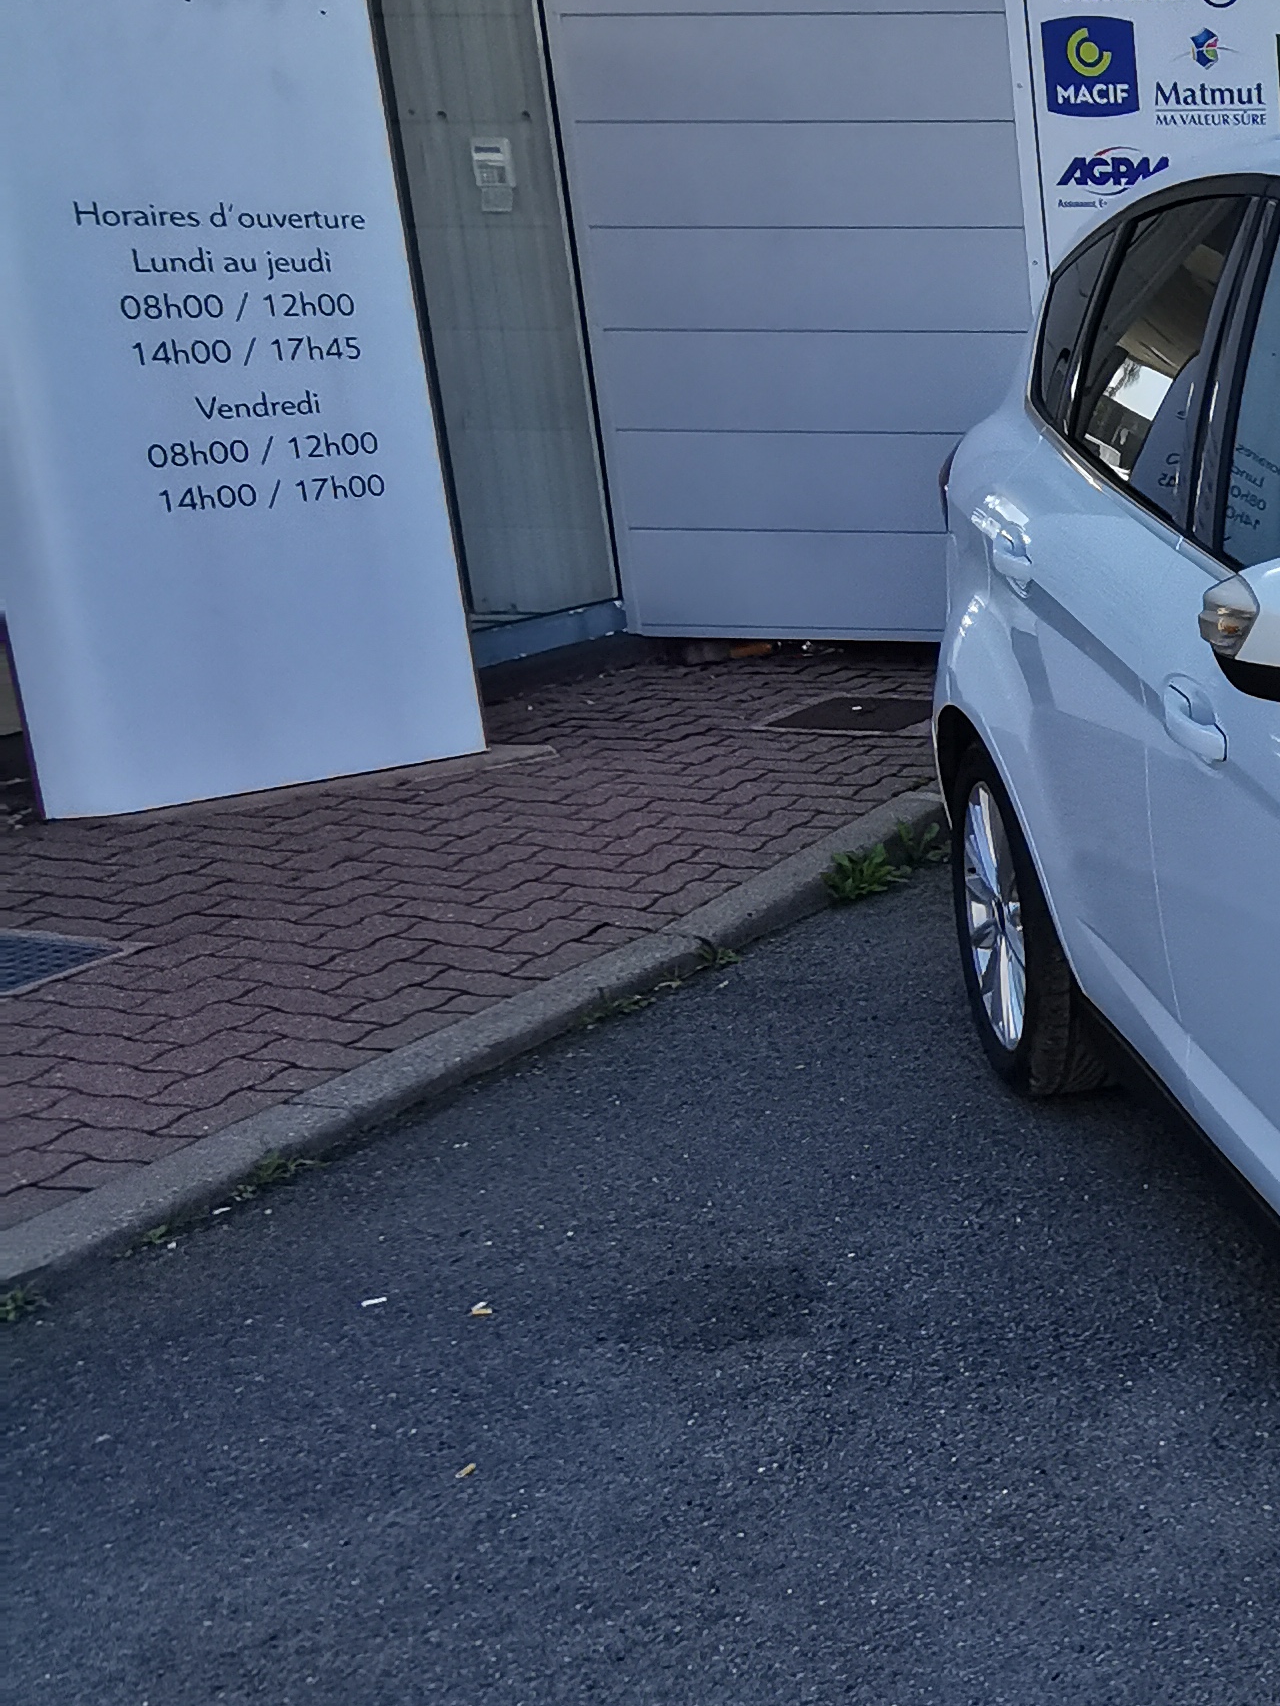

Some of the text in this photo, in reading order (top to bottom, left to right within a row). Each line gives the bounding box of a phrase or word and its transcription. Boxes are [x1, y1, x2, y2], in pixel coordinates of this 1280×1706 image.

[1056, 83, 1130, 105] MACIF
[1154, 80, 1267, 107] Matmut
[1155, 110, 1267, 126] MA VALEUR SÛRE
[73, 200, 201, 229] Horaires
[131, 246, 332, 281] Lundi au jeudi
[120, 293, 224, 321] 08h00
[262, 290, 356, 318] 12h00
[132, 338, 232, 367] 14h00
[270, 335, 362, 362] 17h45
[194, 389, 322, 421] Vendredi
[147, 438, 250, 468] 08h00
[287, 431, 379, 460] 12h00
[159, 482, 258, 513] 14h00
[295, 473, 386, 503] 17h00
